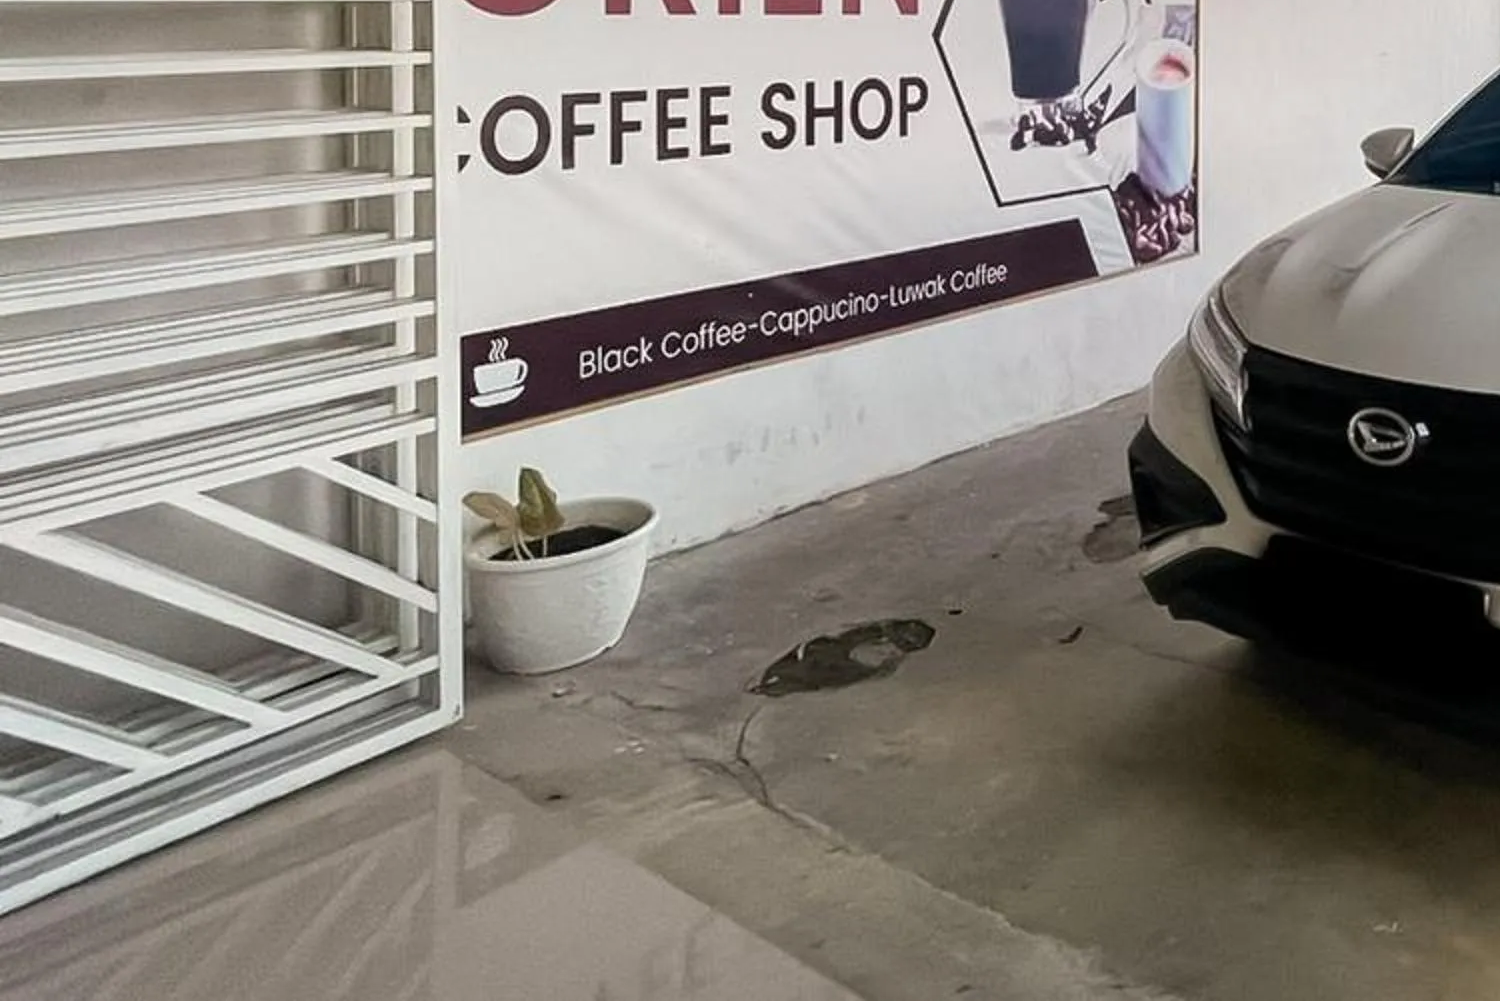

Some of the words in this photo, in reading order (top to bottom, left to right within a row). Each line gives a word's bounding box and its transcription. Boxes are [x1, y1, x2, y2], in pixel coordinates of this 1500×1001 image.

[458, 86, 732, 176] OFFEE
[761, 76, 929, 150] SHOP
[579, 337, 653, 379] Black
[949, 262, 1008, 293] Coffee
